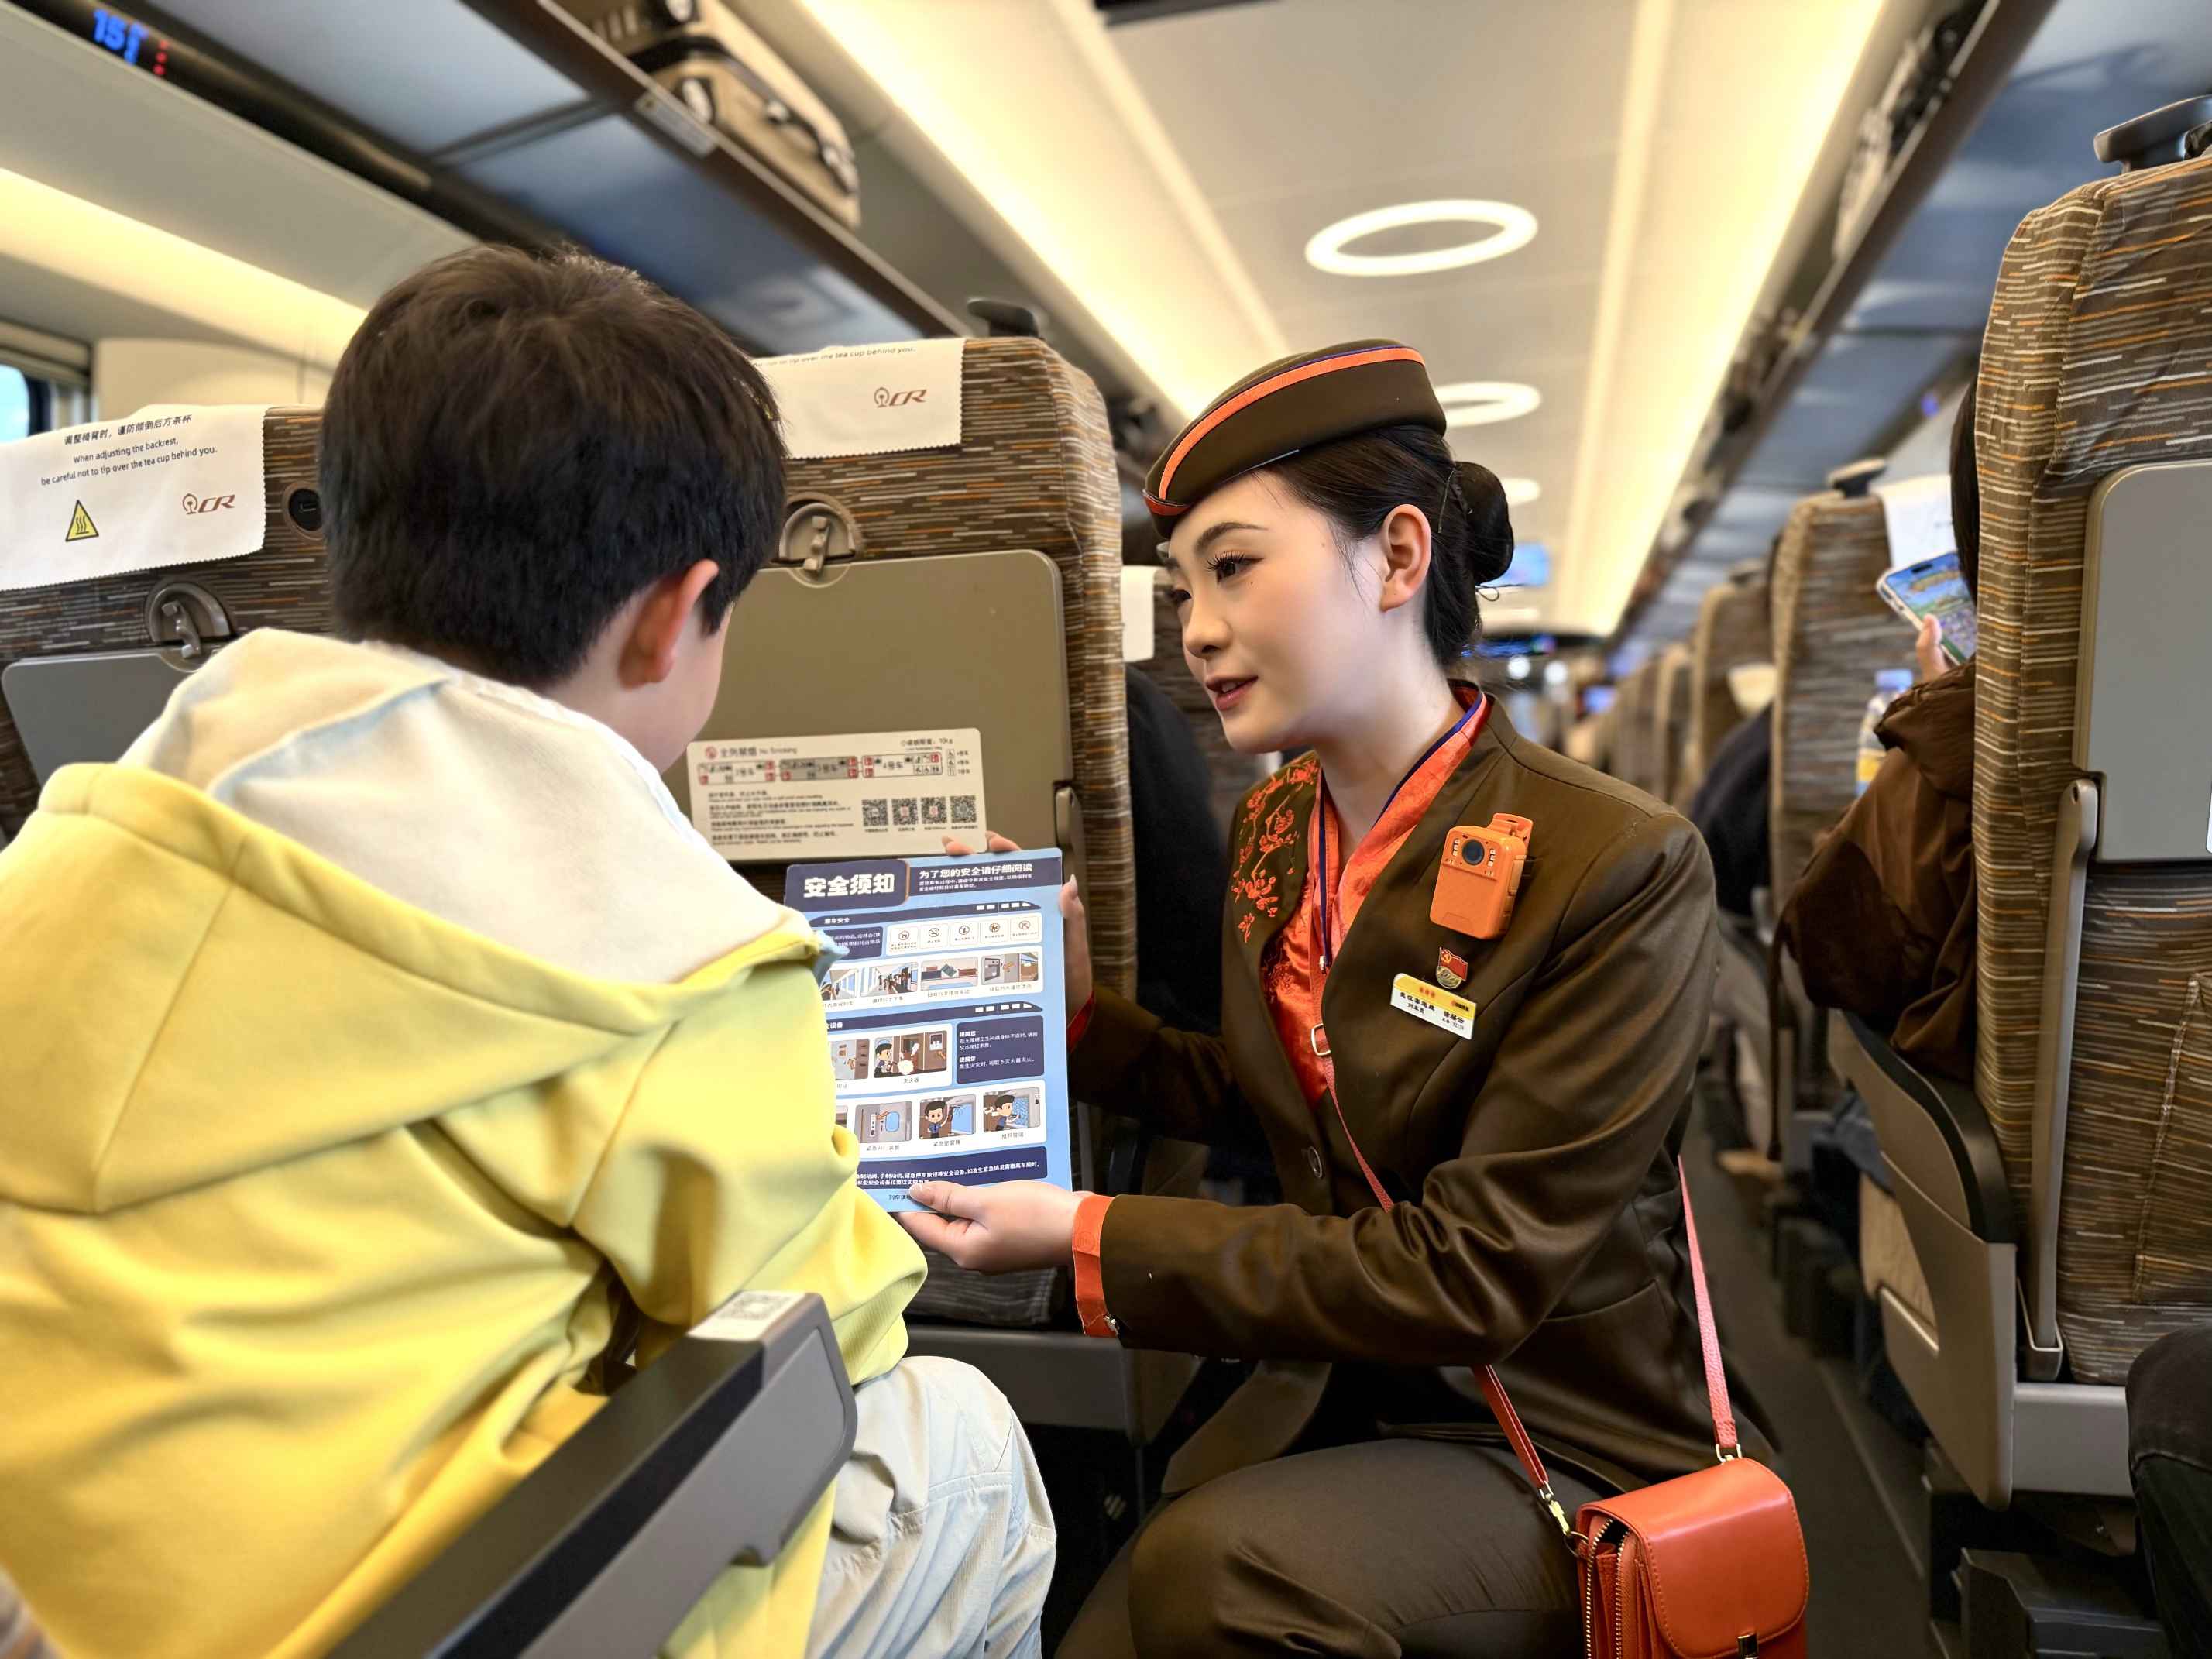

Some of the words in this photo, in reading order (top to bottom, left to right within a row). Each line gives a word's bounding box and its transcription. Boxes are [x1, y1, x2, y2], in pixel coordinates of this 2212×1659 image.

[867, 347, 896, 356] behind
[898, 346, 916, 355] you.
[889, 389, 928, 407] CR
[74, 453, 94, 464] When
[95, 447, 131, 462] adjusting
[132, 444, 144, 453] the
[145, 437, 179, 451] backrest,
[41, 477, 50, 486] be
[52, 471, 76, 485] careful
[77, 469, 90, 478] not
[101, 466, 111, 476] tip
[112, 463, 129, 472] over
[131, 459, 143, 469] the
[144, 458, 156, 466] tea
[156, 455, 170, 465] cup
[171, 448, 198, 460] behind
[198, 446, 218, 457] you.
[198, 494, 235, 514] CR
[919, 864, 1032, 879] 为了您的安全请仔细阅读
[803, 873, 895, 898] 安全须知
